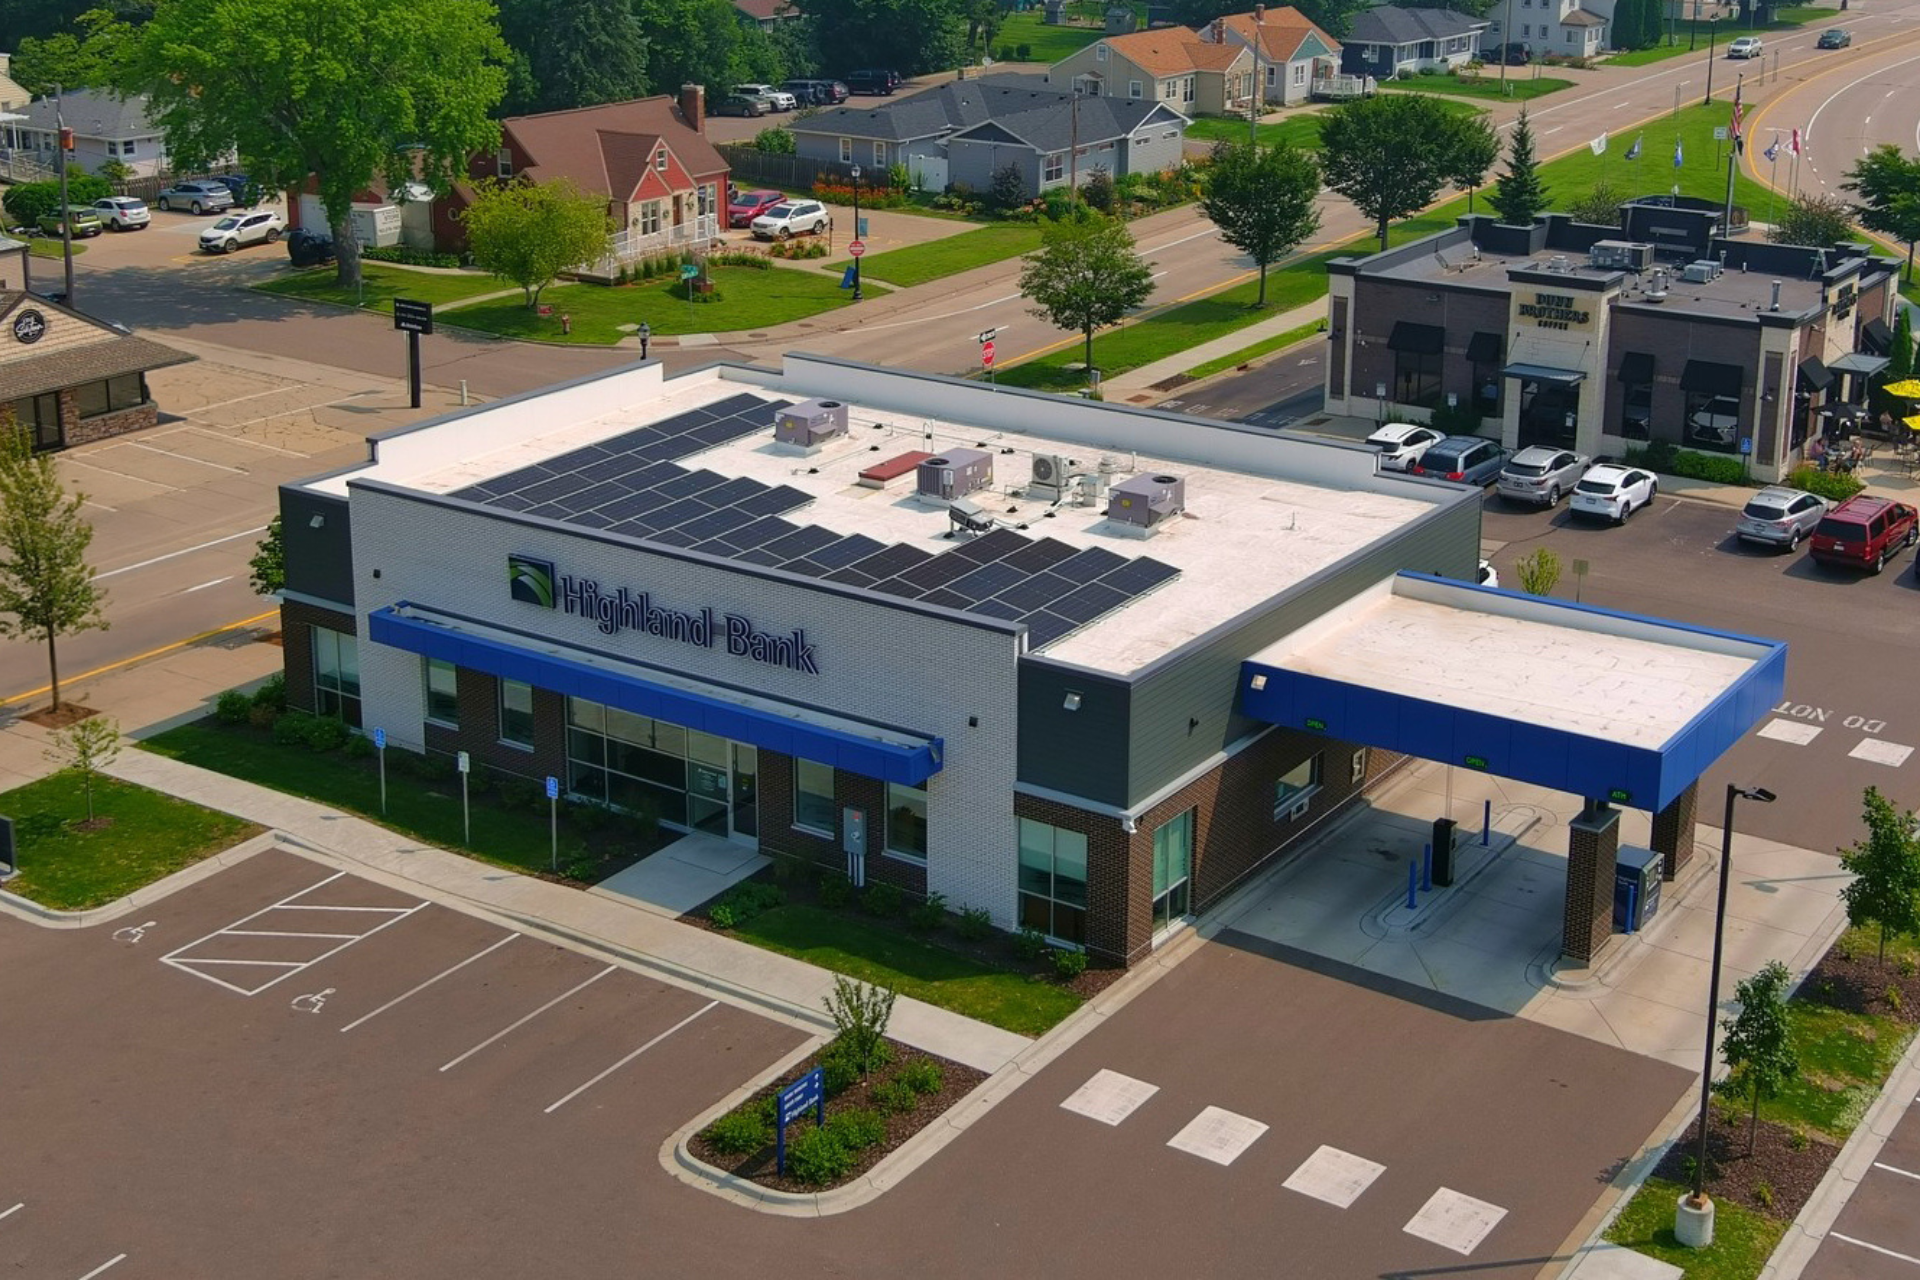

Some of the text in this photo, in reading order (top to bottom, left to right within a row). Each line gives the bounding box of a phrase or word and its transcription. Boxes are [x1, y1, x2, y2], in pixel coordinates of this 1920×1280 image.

[1535, 293, 1575, 309] DUNN
[1519, 303, 1590, 324] BROTHERS
[560, 575, 819, 676] Highland Bank
[1306, 719, 1324, 729] OPEN
[1771, 701, 1888, 734] DO NOT
[1465, 756, 1485, 767] OPEN
[1611, 791, 1626, 799] ATM
